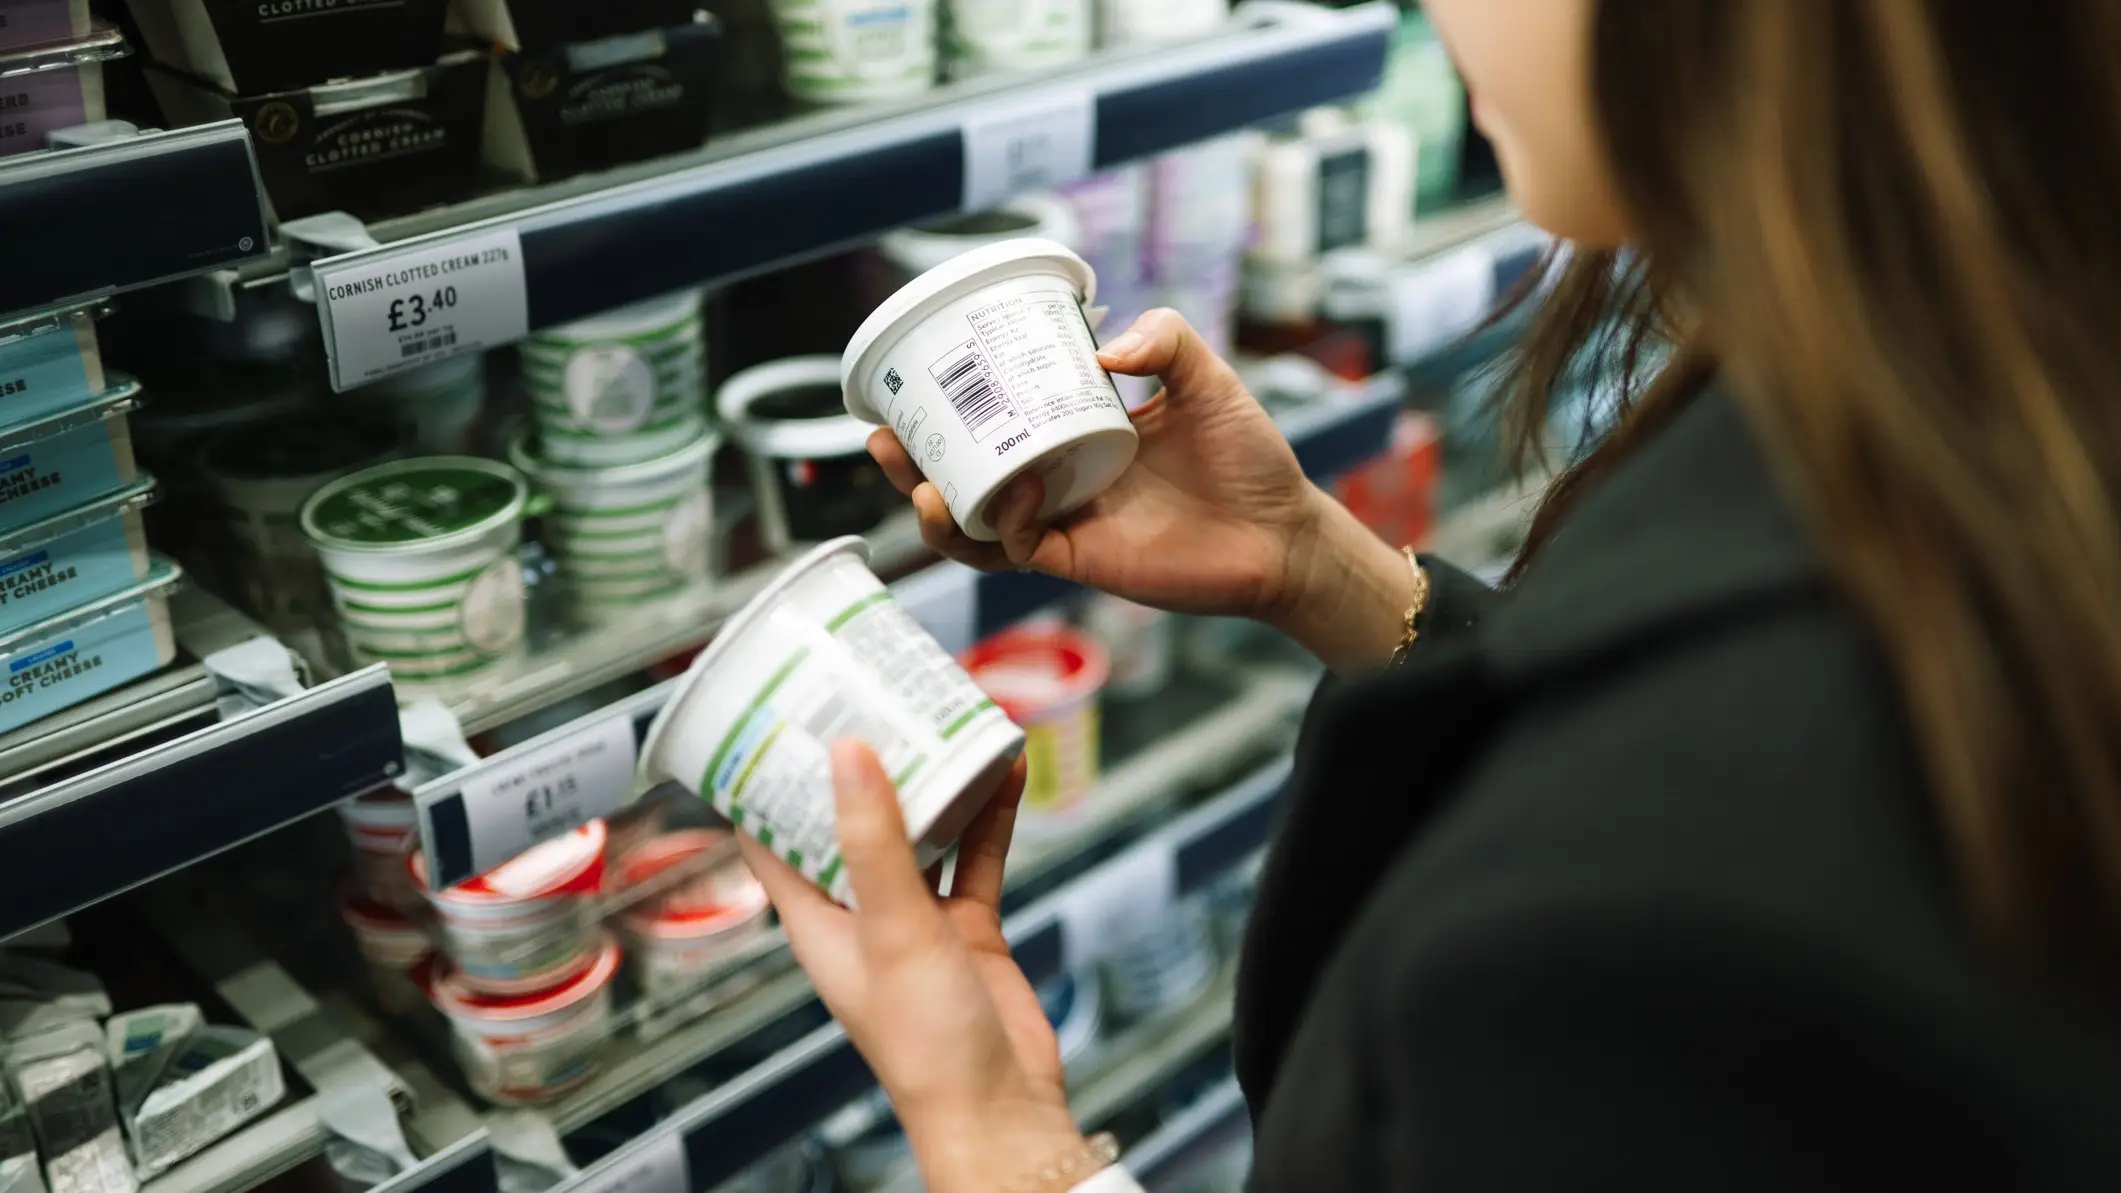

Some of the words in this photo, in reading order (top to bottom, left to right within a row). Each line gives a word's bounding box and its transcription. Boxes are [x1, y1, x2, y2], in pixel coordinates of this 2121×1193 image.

[328, 277, 383, 301] CORNISH
[386, 263, 439, 287] CLOTTED
[441, 253, 479, 274] CREAM
[387, 286, 457, 332] £3.40
[970, 298, 1022, 322] NUTRITION
[981, 323, 1004, 337] Typical
[974, 354, 992, 378] 9659
[990, 380, 1010, 406] 2908
[1031, 413, 1061, 429] Saturates
[13, 565, 78, 599] CHEESE
[0, 682, 34, 706] OFT
[40, 655, 102, 688] CHEESE
[9, 651, 78, 688] CREAMY
